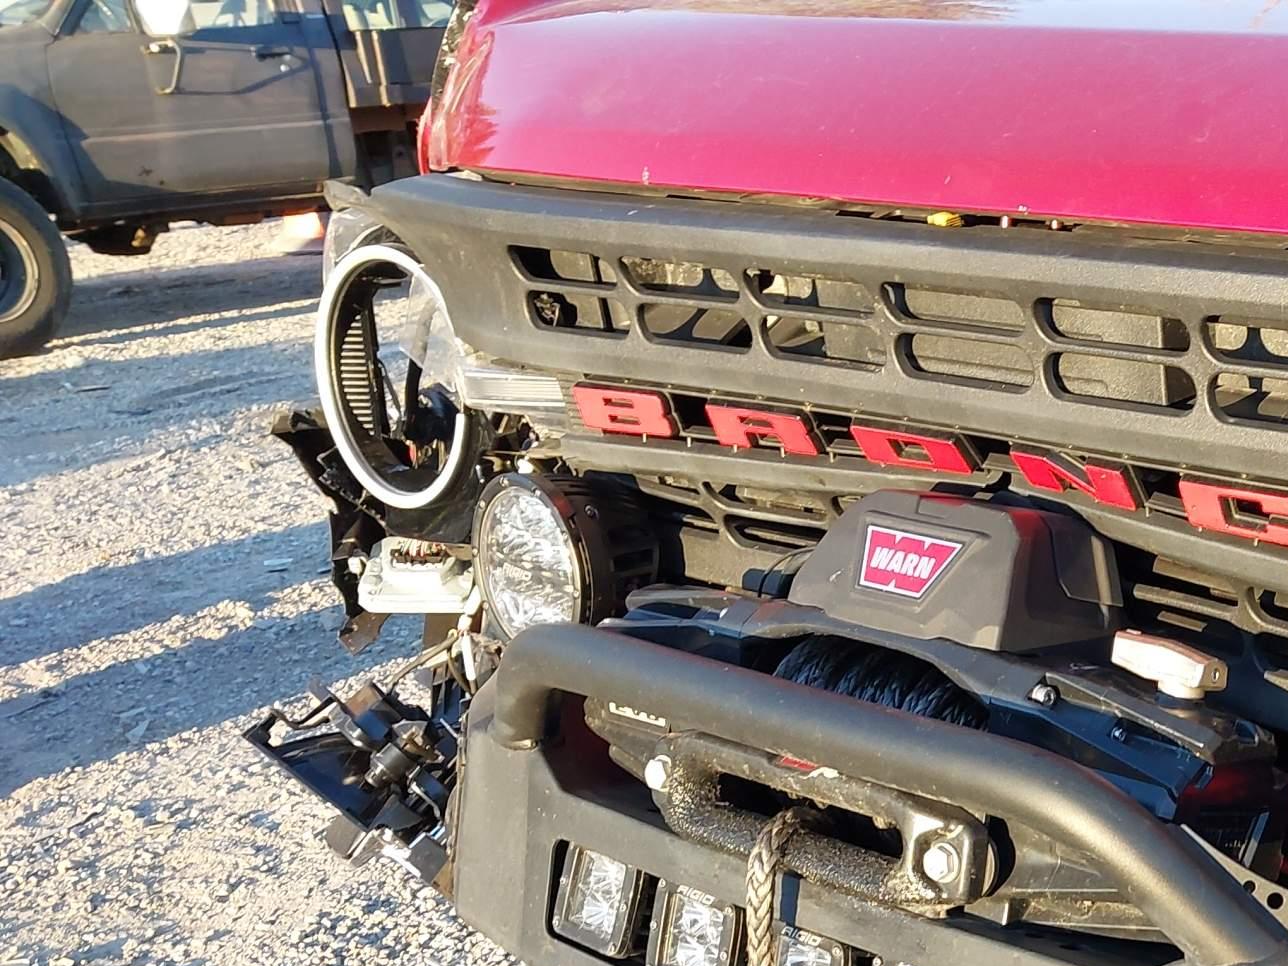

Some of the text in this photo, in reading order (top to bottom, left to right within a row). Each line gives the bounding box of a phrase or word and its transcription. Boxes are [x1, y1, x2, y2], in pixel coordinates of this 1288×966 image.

[870, 547, 936, 579] WARN
[677, 885, 716, 905] RIGID
[781, 926, 822, 946] RIGID
